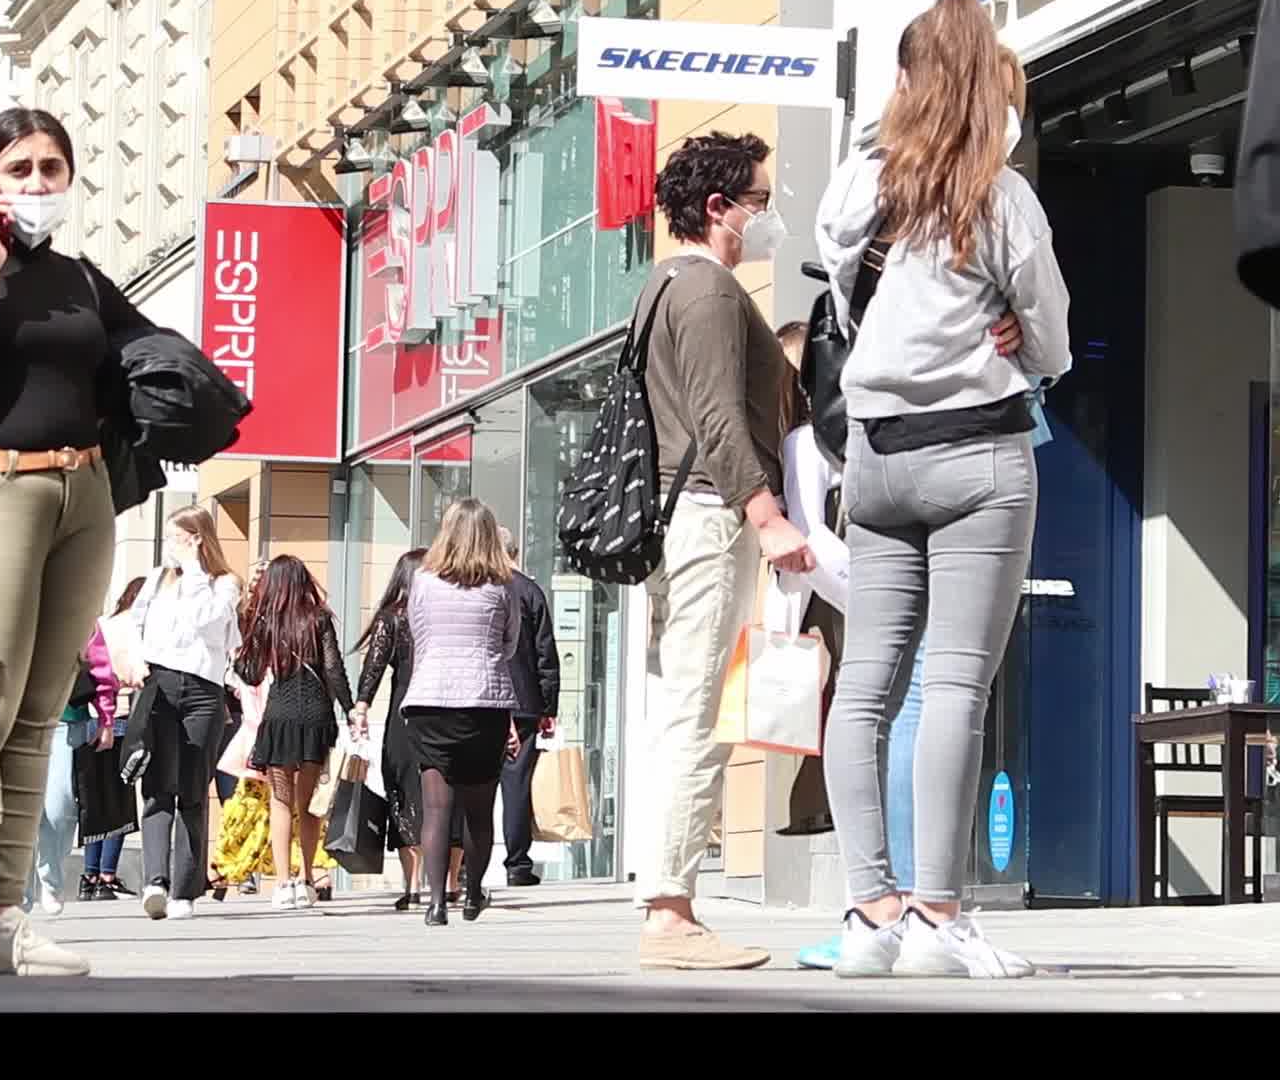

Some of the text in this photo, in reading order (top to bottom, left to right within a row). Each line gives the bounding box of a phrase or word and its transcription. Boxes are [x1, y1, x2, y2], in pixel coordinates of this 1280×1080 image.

[597, 48, 818, 77] SKECHERS
[366, 103, 504, 352] ESPRIT
[213, 230, 259, 400] ESPRIT
